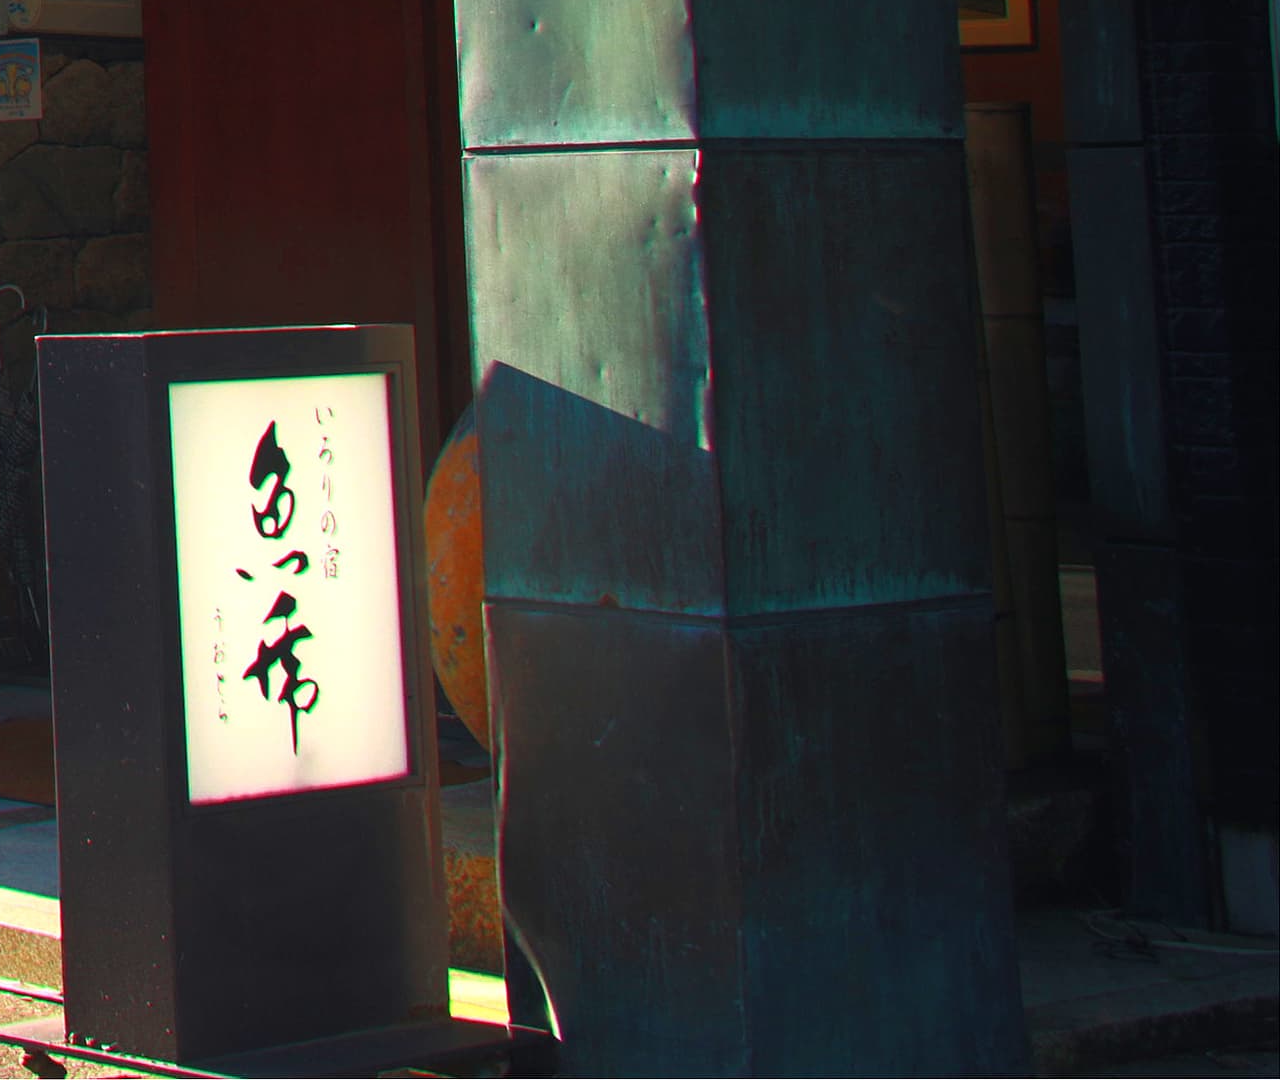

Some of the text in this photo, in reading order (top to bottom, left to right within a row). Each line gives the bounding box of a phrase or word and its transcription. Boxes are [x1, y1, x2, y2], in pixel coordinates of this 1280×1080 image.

[314, 406, 340, 580] いろりの宿
